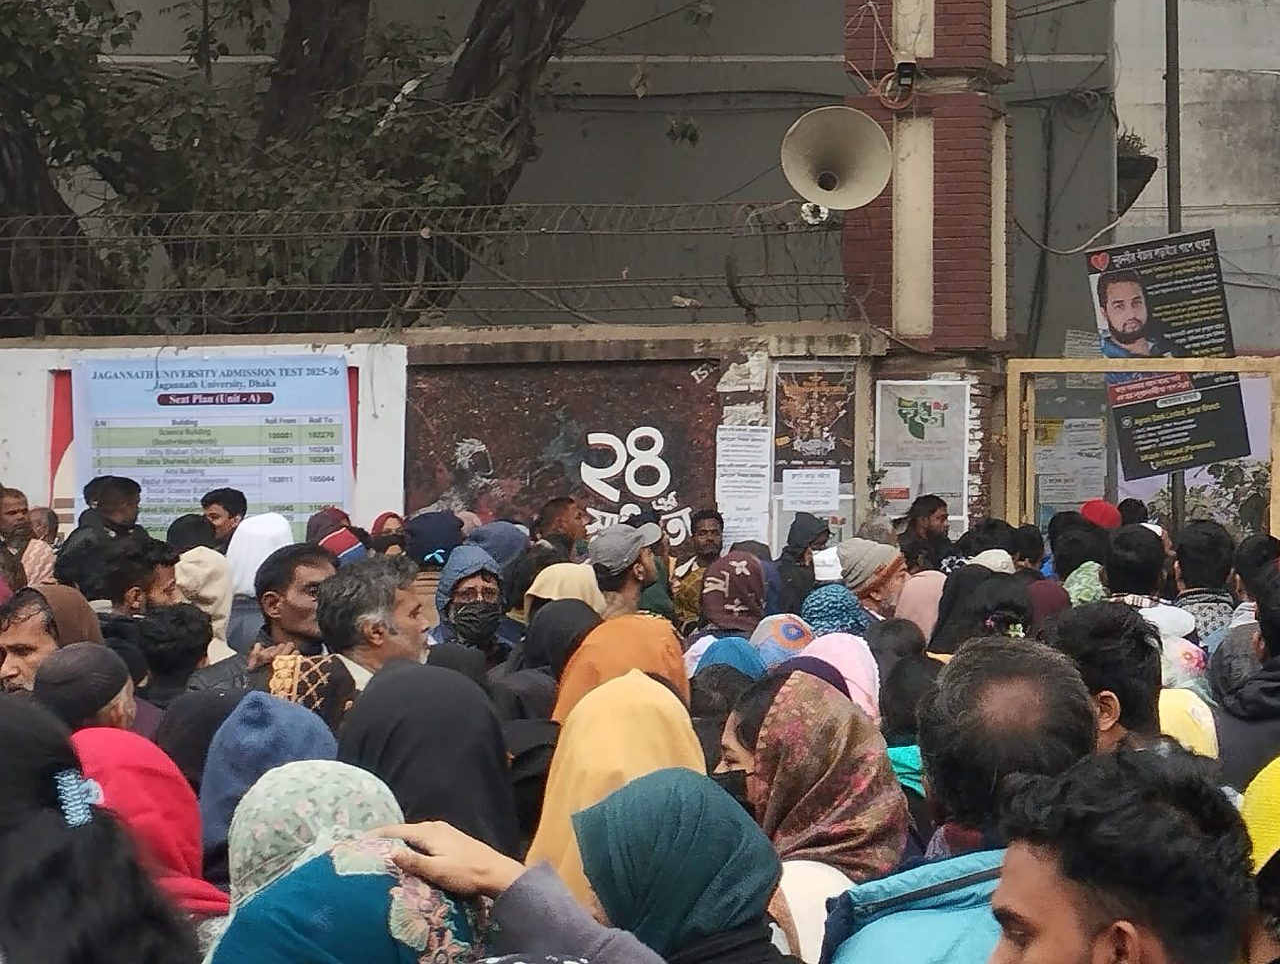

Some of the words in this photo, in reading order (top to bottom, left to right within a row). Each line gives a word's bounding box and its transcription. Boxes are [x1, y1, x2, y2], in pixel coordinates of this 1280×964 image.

[92, 370, 153, 380] JAGANNATH
[155, 369, 218, 379] UNIVERSITY
[219, 368, 276, 378] ADMISSION
[278, 368, 303, 377] TEST
[306, 367, 340, 376] 2025-26
[154, 379, 198, 390] Jagannath
[248, 379, 276, 388] Dhaka
[169, 395, 190, 404] Seat
[192, 394, 213, 404] Plan
[171, 418, 198, 427] Building
[580, 427, 671, 503] ২৪
